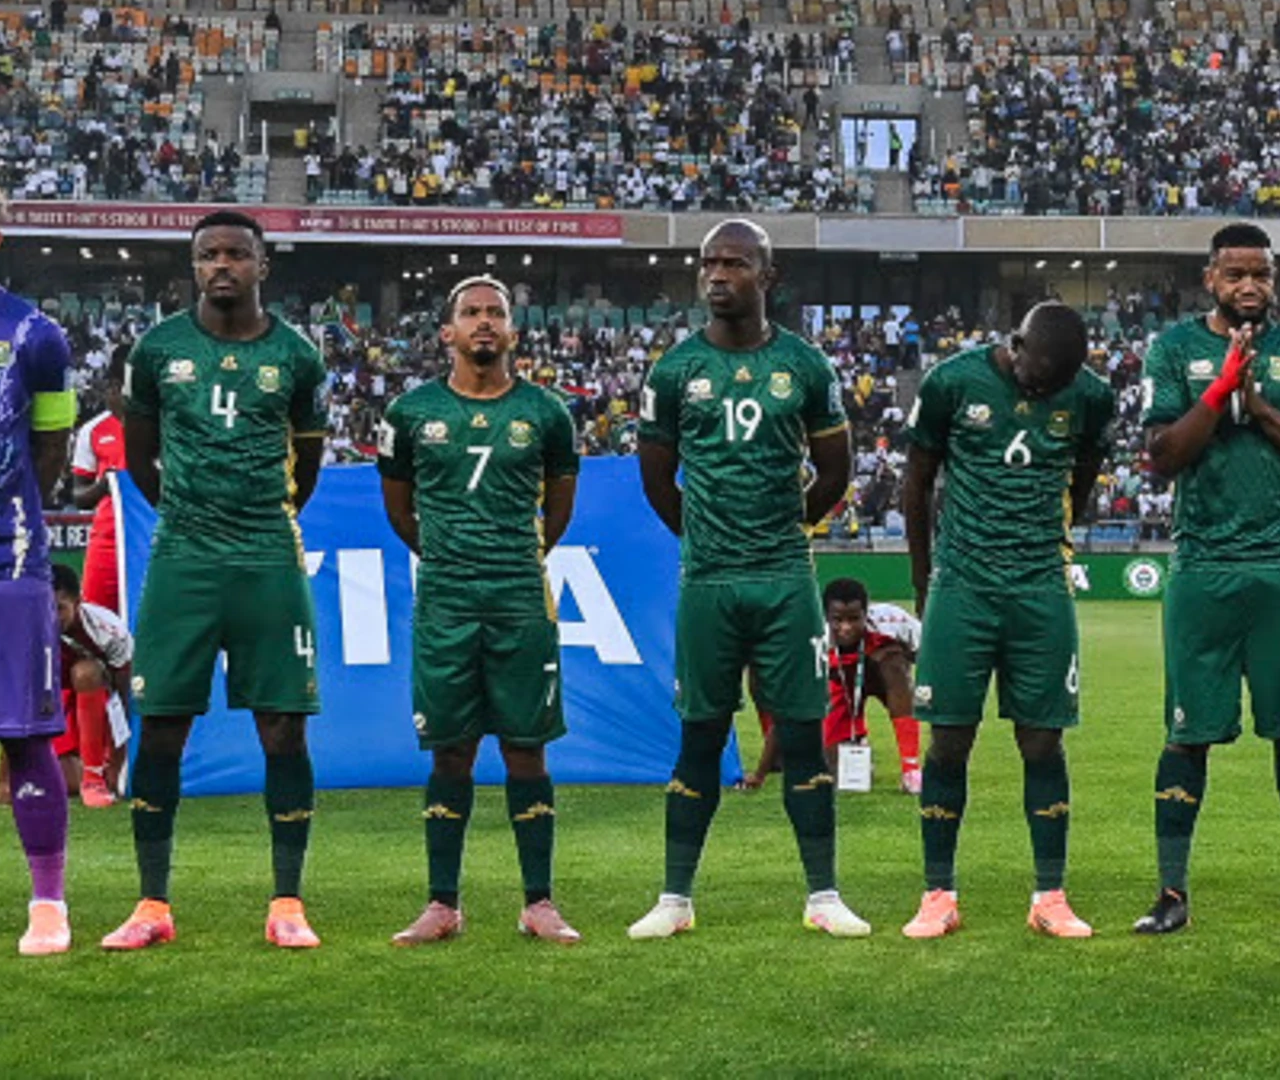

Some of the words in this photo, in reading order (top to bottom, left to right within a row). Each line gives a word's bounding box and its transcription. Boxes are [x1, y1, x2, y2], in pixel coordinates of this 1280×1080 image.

[210, 384, 238, 428] 4
[719, 397, 763, 442] 19
[466, 445, 494, 493] 7
[1004, 429, 1032, 467] 6
[43, 646, 54, 692] 1
[292, 624, 316, 670] 4
[542, 662, 558, 708] 7
[1064, 653, 1079, 695] 6
